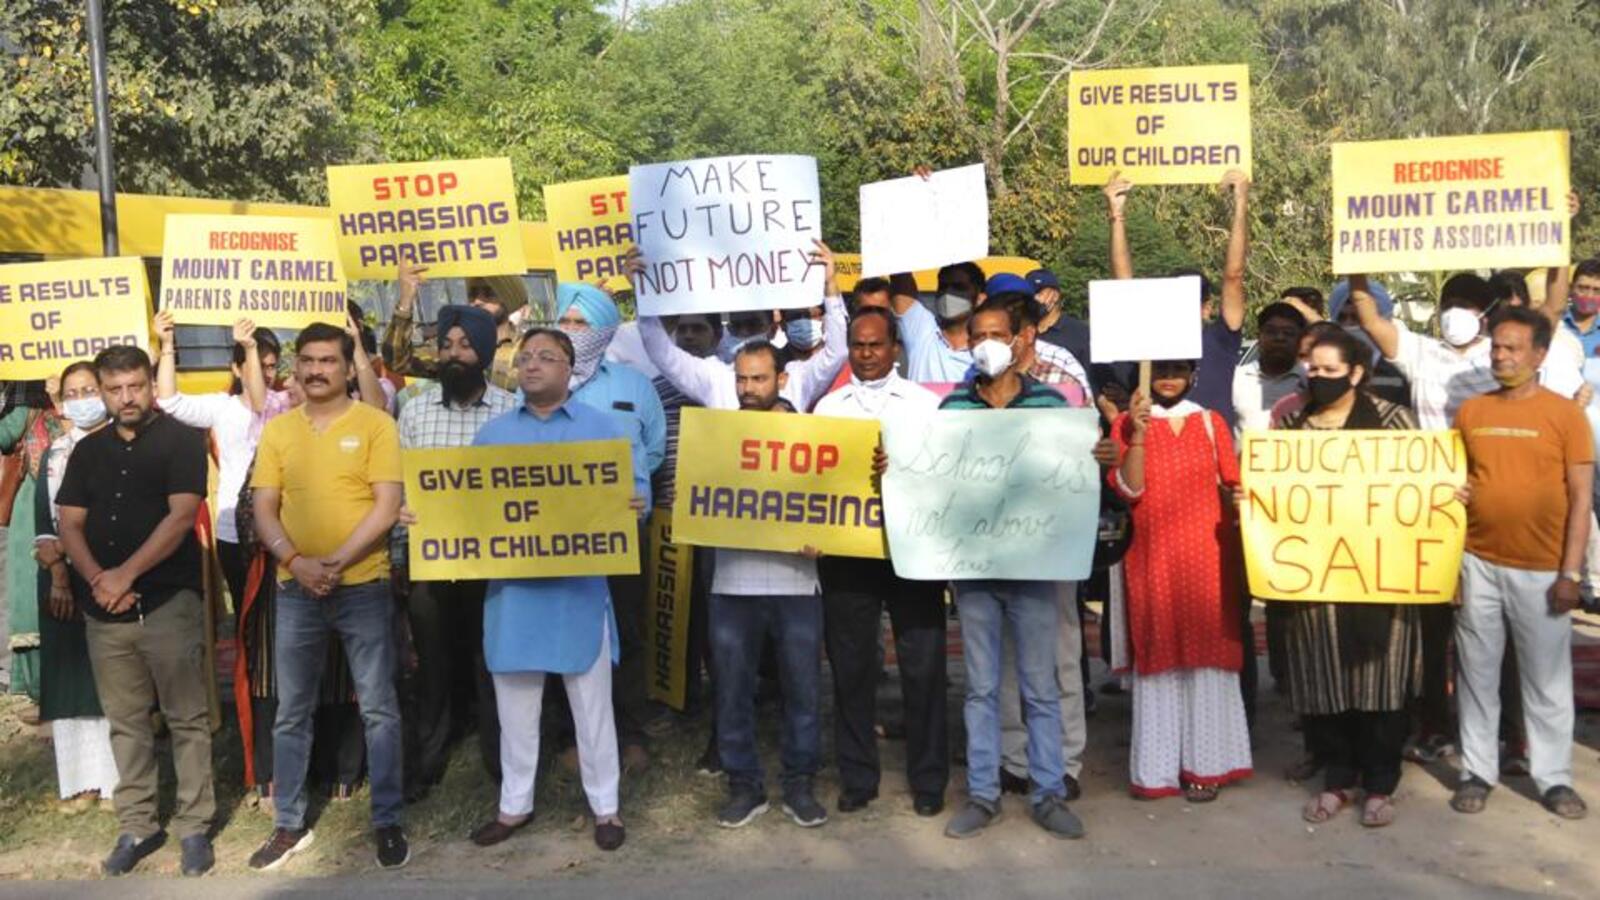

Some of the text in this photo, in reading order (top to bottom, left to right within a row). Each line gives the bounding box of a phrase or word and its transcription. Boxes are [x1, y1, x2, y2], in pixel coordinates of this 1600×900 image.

[1079, 81, 1238, 106] GIVE RESULTS
[1135, 115, 1165, 135] OF
[1077, 144, 1241, 167] OUR CHILDREN
[1393, 157, 1505, 184] RECOGNISE
[373, 171, 459, 201] STOP
[660, 160, 778, 198] MAKE
[590, 190, 627, 216] ST
[1347, 186, 1554, 220] MOUNT CARMEL
[339, 201, 510, 236] HARASSING
[636, 200, 813, 244] FUTURE
[209, 231, 299, 253] RECOGNISE
[359, 236, 499, 268] PARENTS
[1339, 221, 1563, 254] PARENTS ASSOCIATION
[172, 258, 338, 283] MOUNT CARMEL
[636, 258, 694, 296] NOT
[709, 248, 817, 291] MONEY
[19, 275, 131, 302] RESULTS
[164, 288, 346, 314] PARENTS ASSOCIATION
[30, 311, 62, 331] OF
[740, 439, 840, 476] STOP
[1248, 435, 1460, 475] EDUCATION
[419, 461, 619, 491] GIVE RESULTS
[503, 500, 540, 523] OF
[689, 485, 884, 528] HARASSING
[1247, 482, 1461, 531] NOT FOR
[421, 531, 628, 561] OUR CHILDREN
[1267, 535, 1445, 596] SALE
